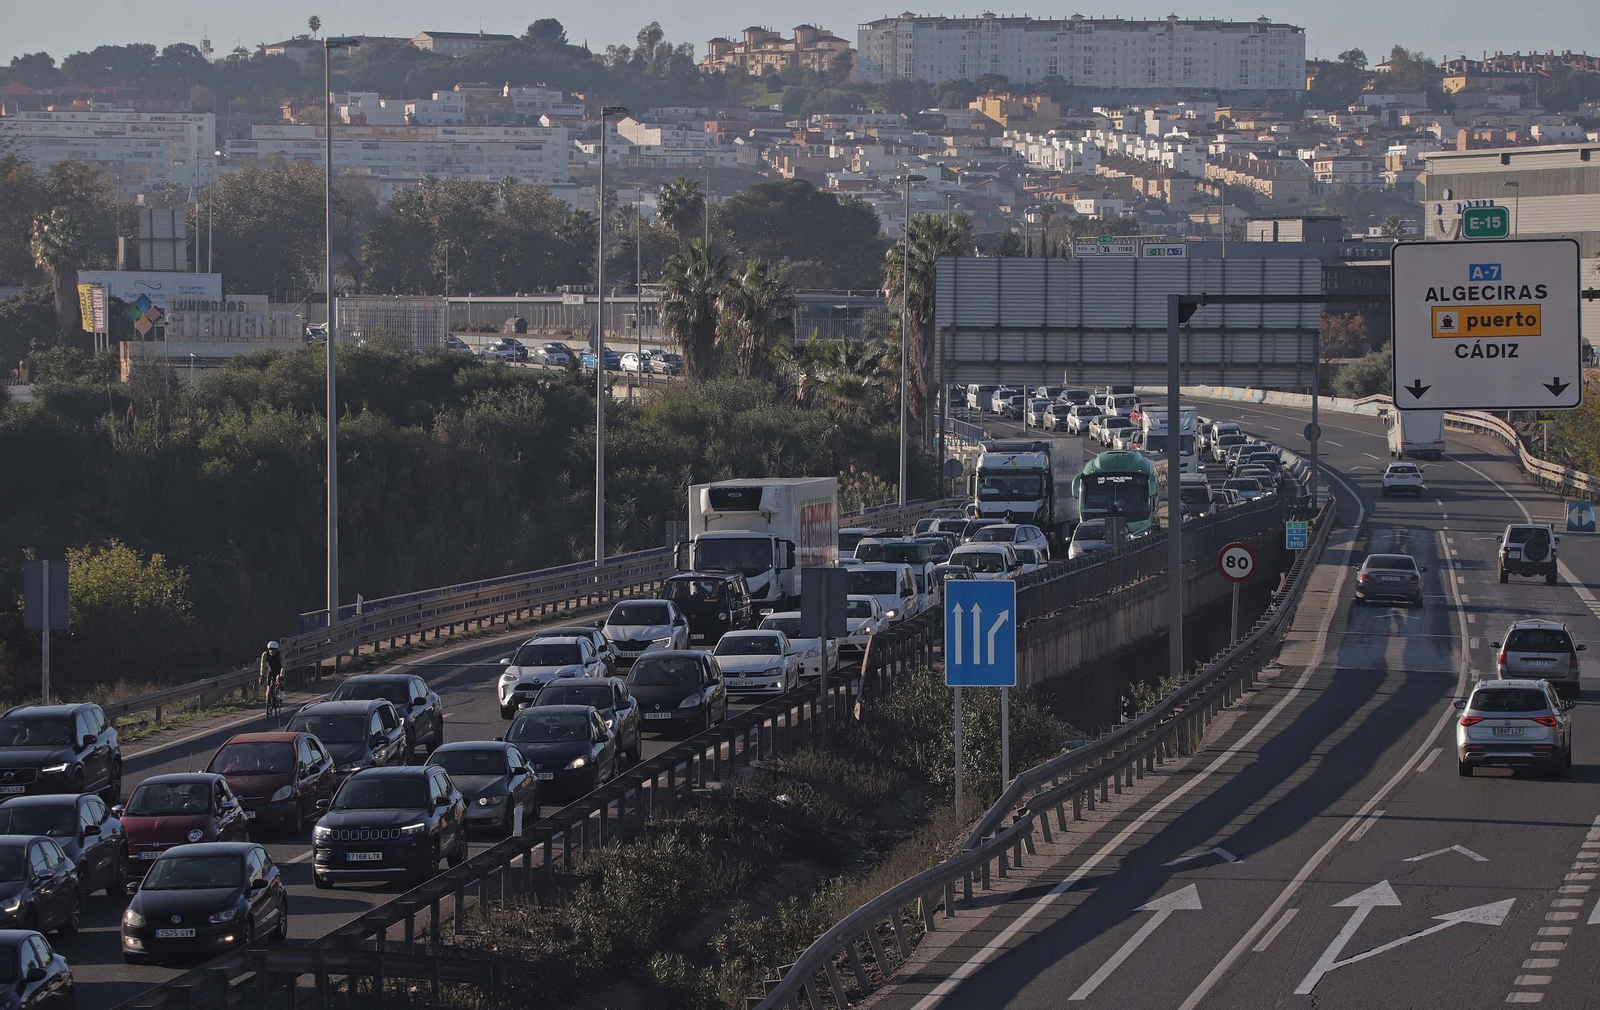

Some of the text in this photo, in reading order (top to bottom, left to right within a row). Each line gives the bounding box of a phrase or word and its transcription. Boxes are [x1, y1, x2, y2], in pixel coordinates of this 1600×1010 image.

[1470, 216, 1502, 230] E-15
[1472, 266, 1499, 278] A-7
[1425, 284, 1548, 302] ALGECIRAS
[168, 312, 301, 338] CLEMENTE
[1467, 312, 1536, 332] puerto
[1455, 340, 1518, 358] CÁDIZ
[1226, 555, 1249, 568] 80
